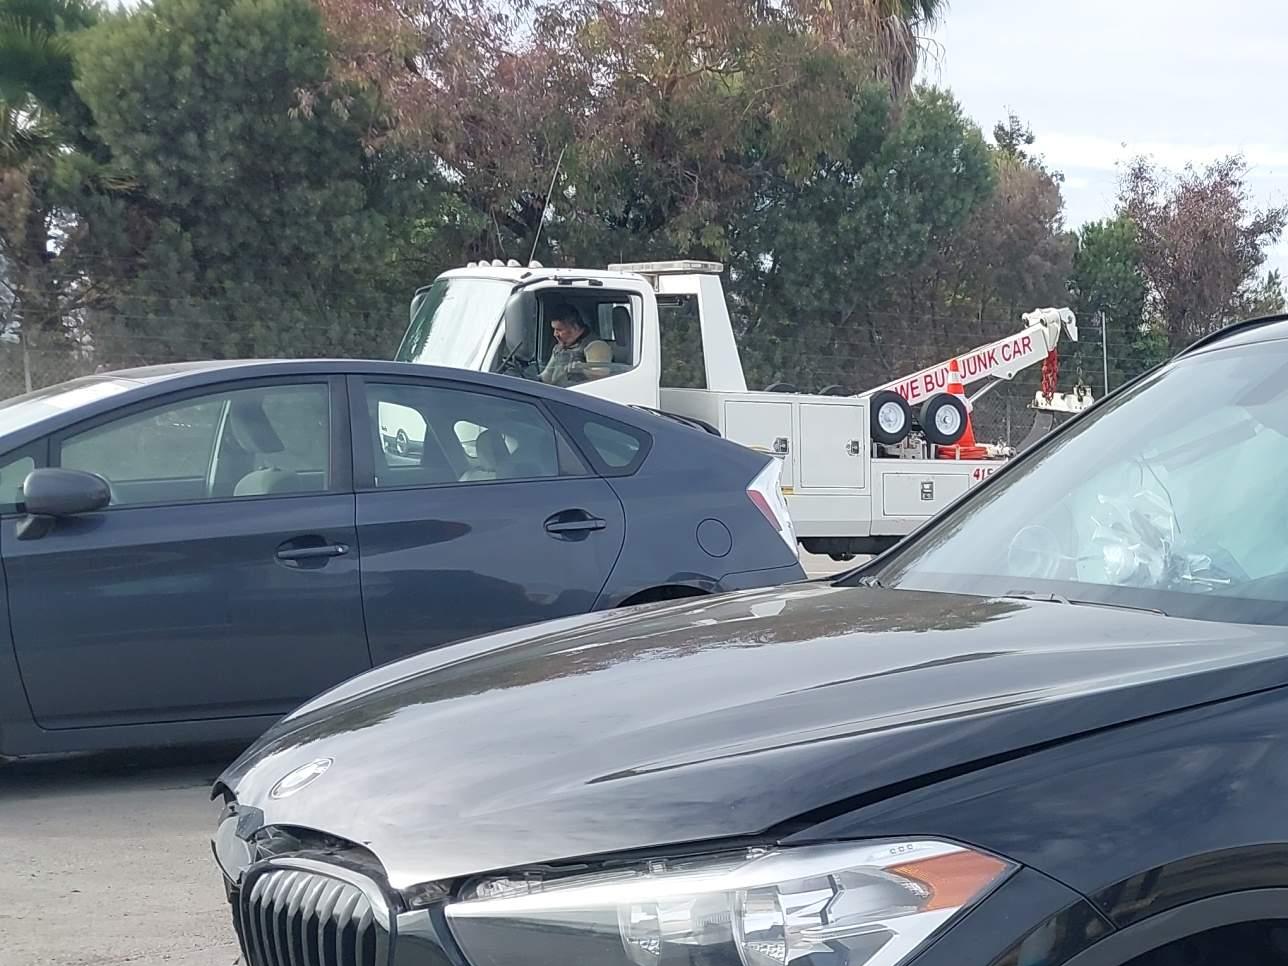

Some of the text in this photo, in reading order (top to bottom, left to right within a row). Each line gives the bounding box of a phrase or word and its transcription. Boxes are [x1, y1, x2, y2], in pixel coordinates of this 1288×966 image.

[895, 379, 922, 401] WE
[960, 348, 999, 379] JUNK
[1001, 335, 1033, 362] CAR
